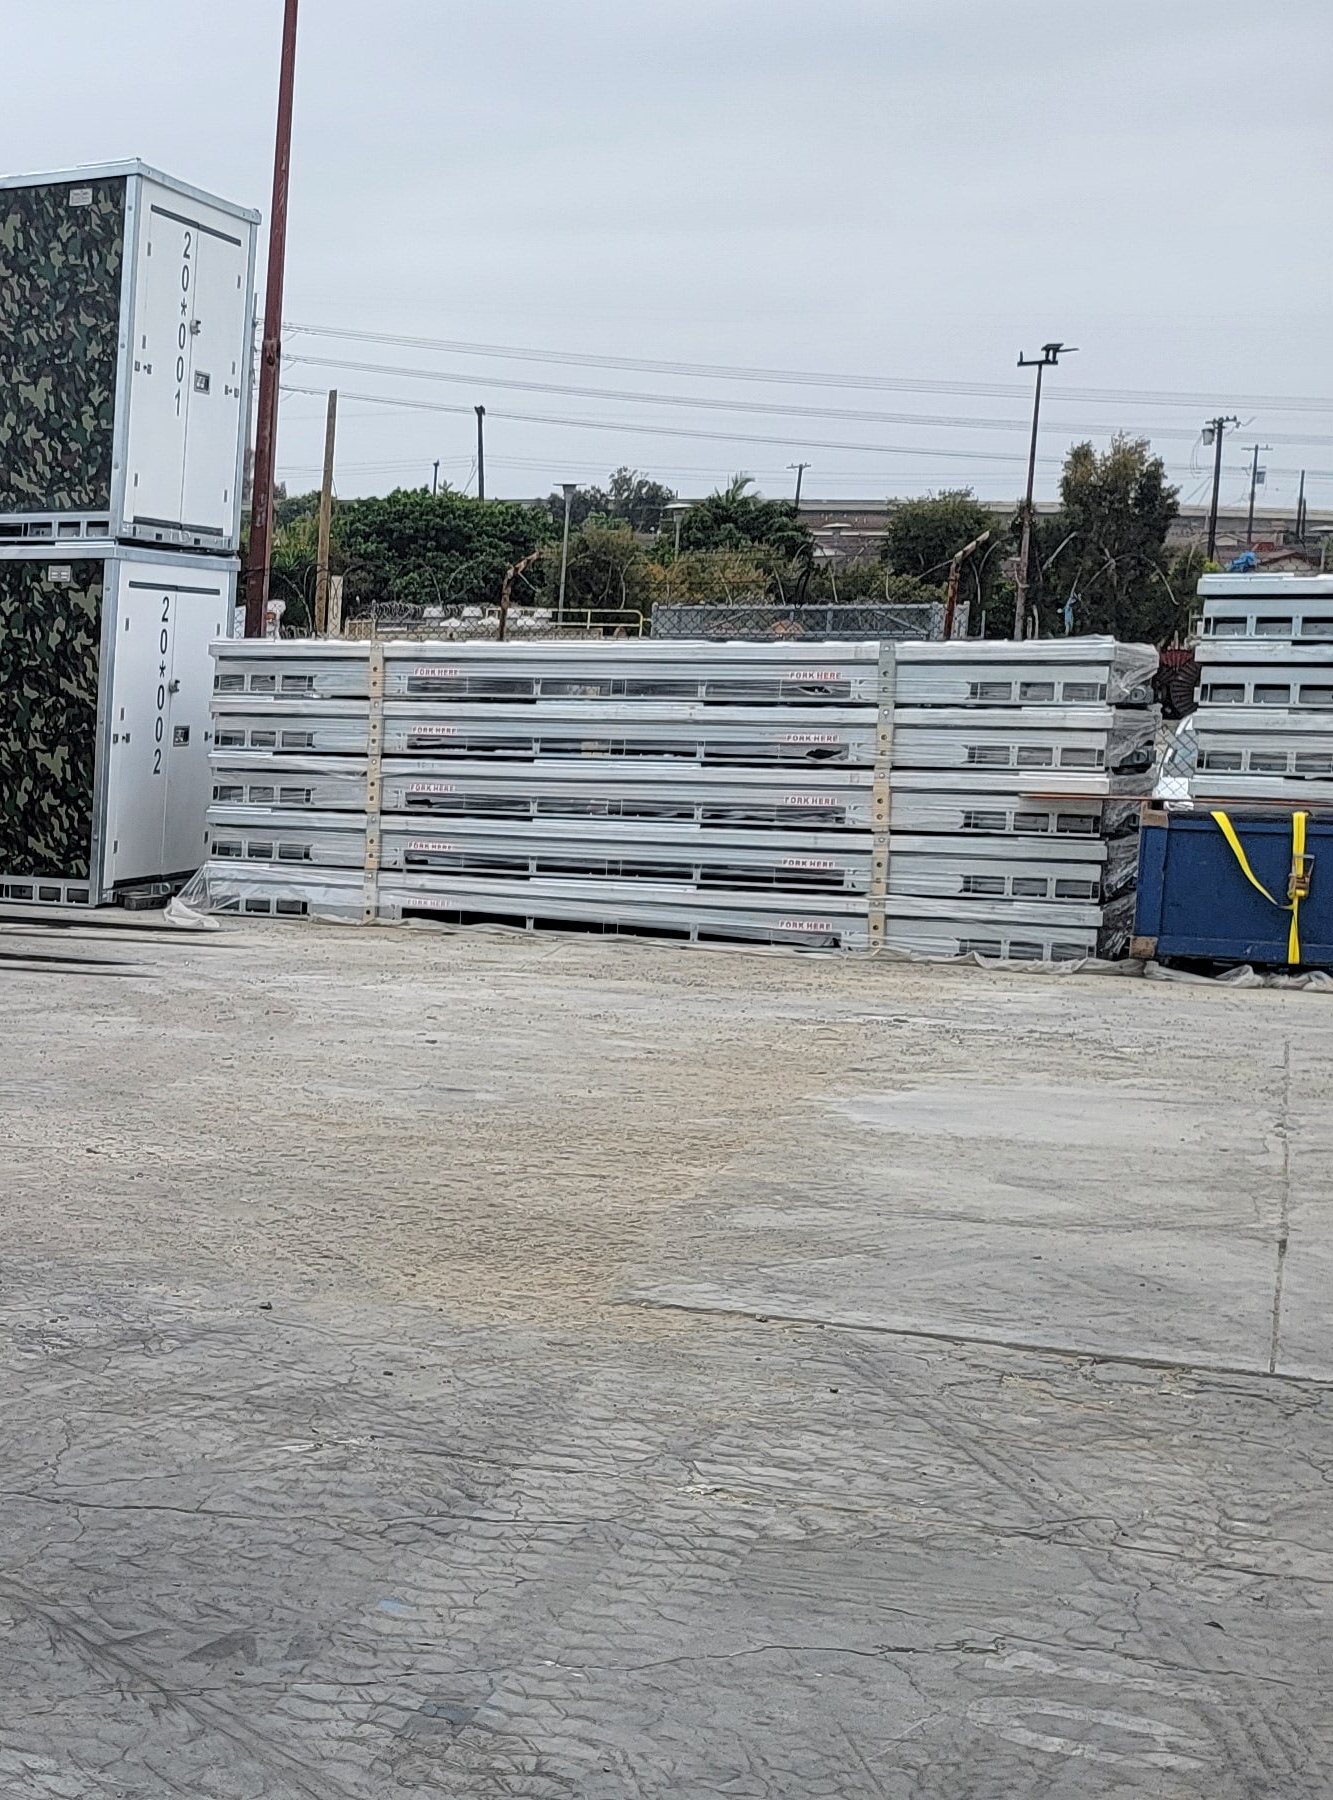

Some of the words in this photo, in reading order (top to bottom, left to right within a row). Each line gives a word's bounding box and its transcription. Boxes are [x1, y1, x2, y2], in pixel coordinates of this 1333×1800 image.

[816, 671, 842, 679] HERE
[784, 796, 810, 805] FORK
[811, 797, 836, 806] HERE
